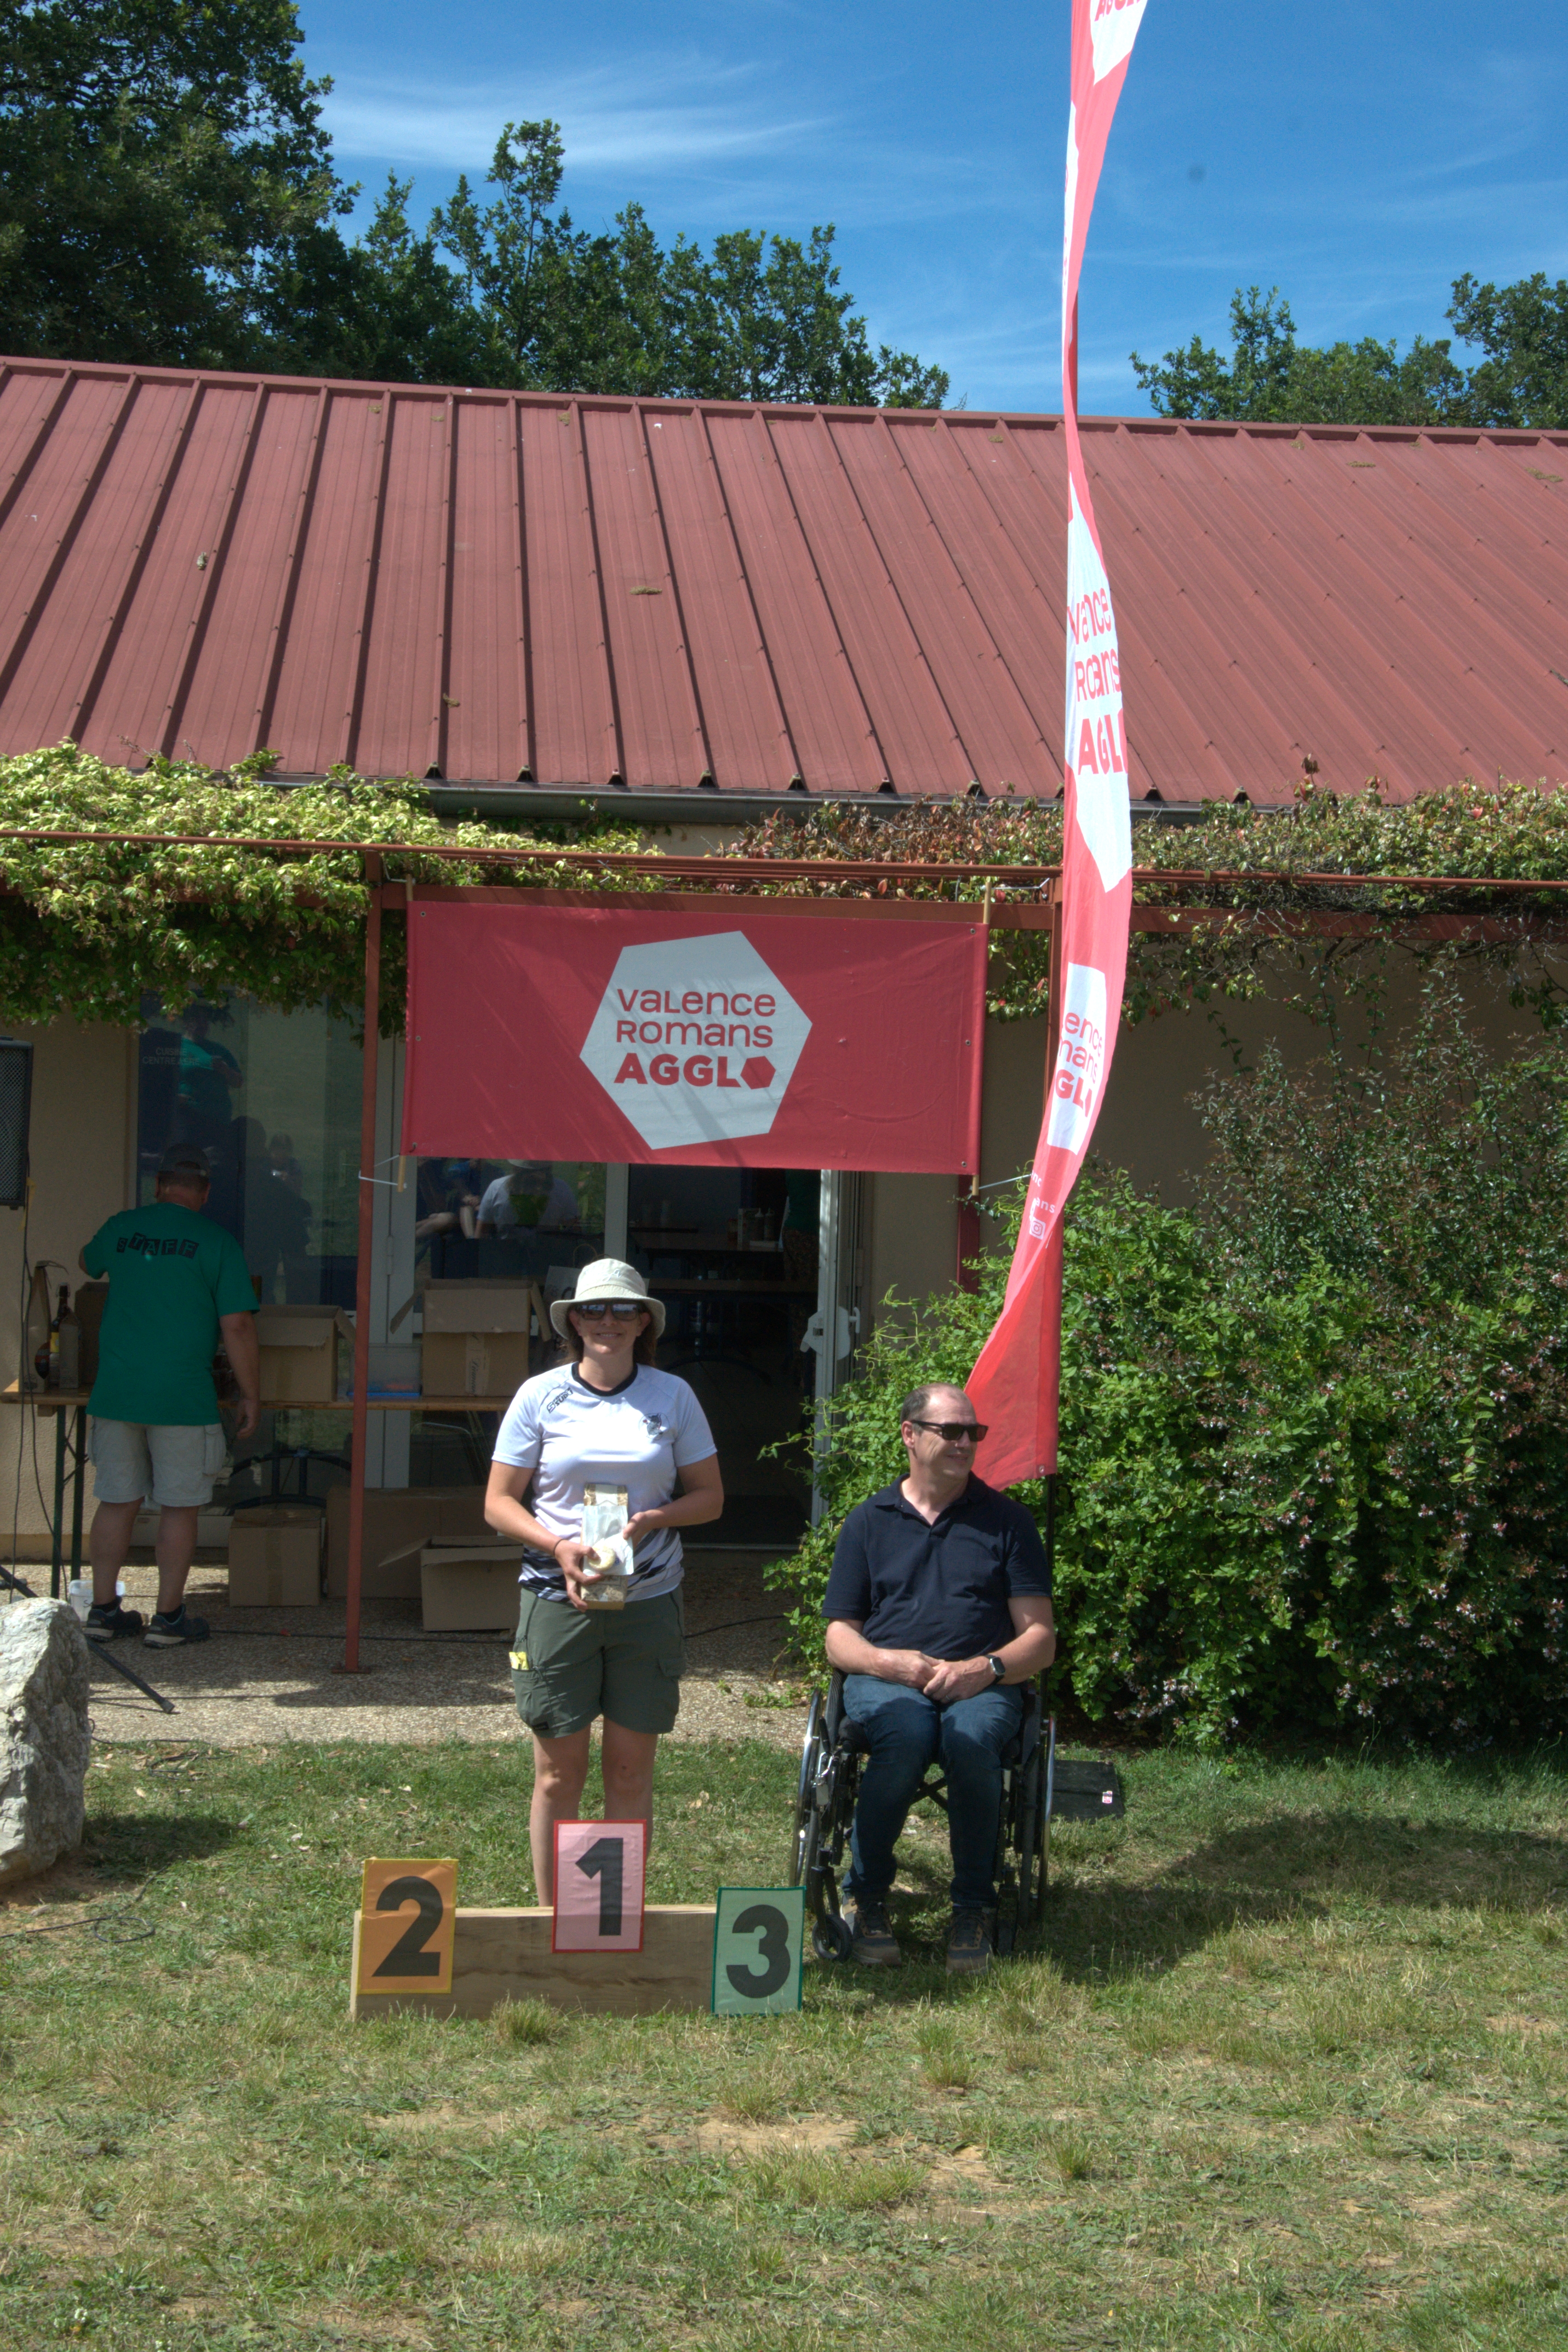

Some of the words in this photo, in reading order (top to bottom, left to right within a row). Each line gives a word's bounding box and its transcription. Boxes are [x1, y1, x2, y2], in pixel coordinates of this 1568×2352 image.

[117, 1233, 199, 1258] STAFF
[372, 1876, 444, 1977] 2
[575, 1838, 623, 1936] 1
[726, 1904, 791, 1999] 3
